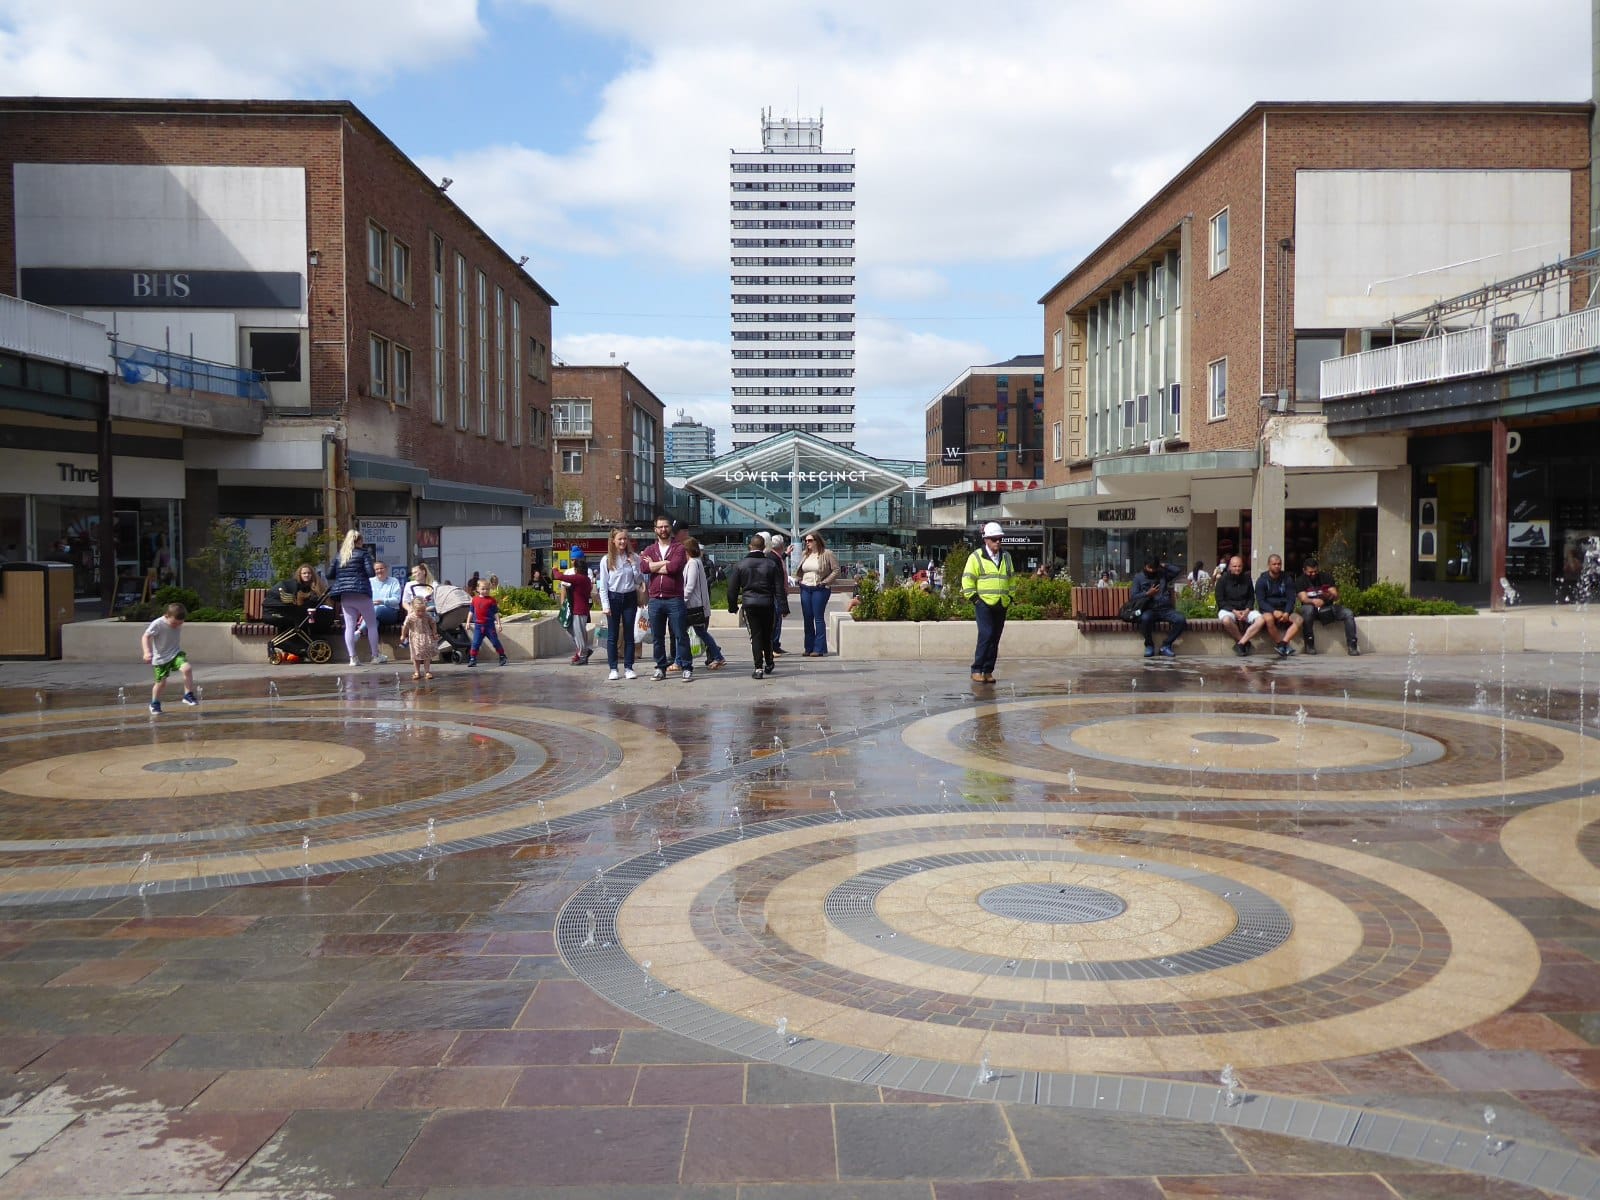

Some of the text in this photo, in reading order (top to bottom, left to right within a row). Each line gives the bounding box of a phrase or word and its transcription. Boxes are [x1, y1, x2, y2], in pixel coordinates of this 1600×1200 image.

[133, 273, 190, 298] BHS
[945, 447, 960, 458] W
[725, 471, 868, 481] LOWER PRECINCT
